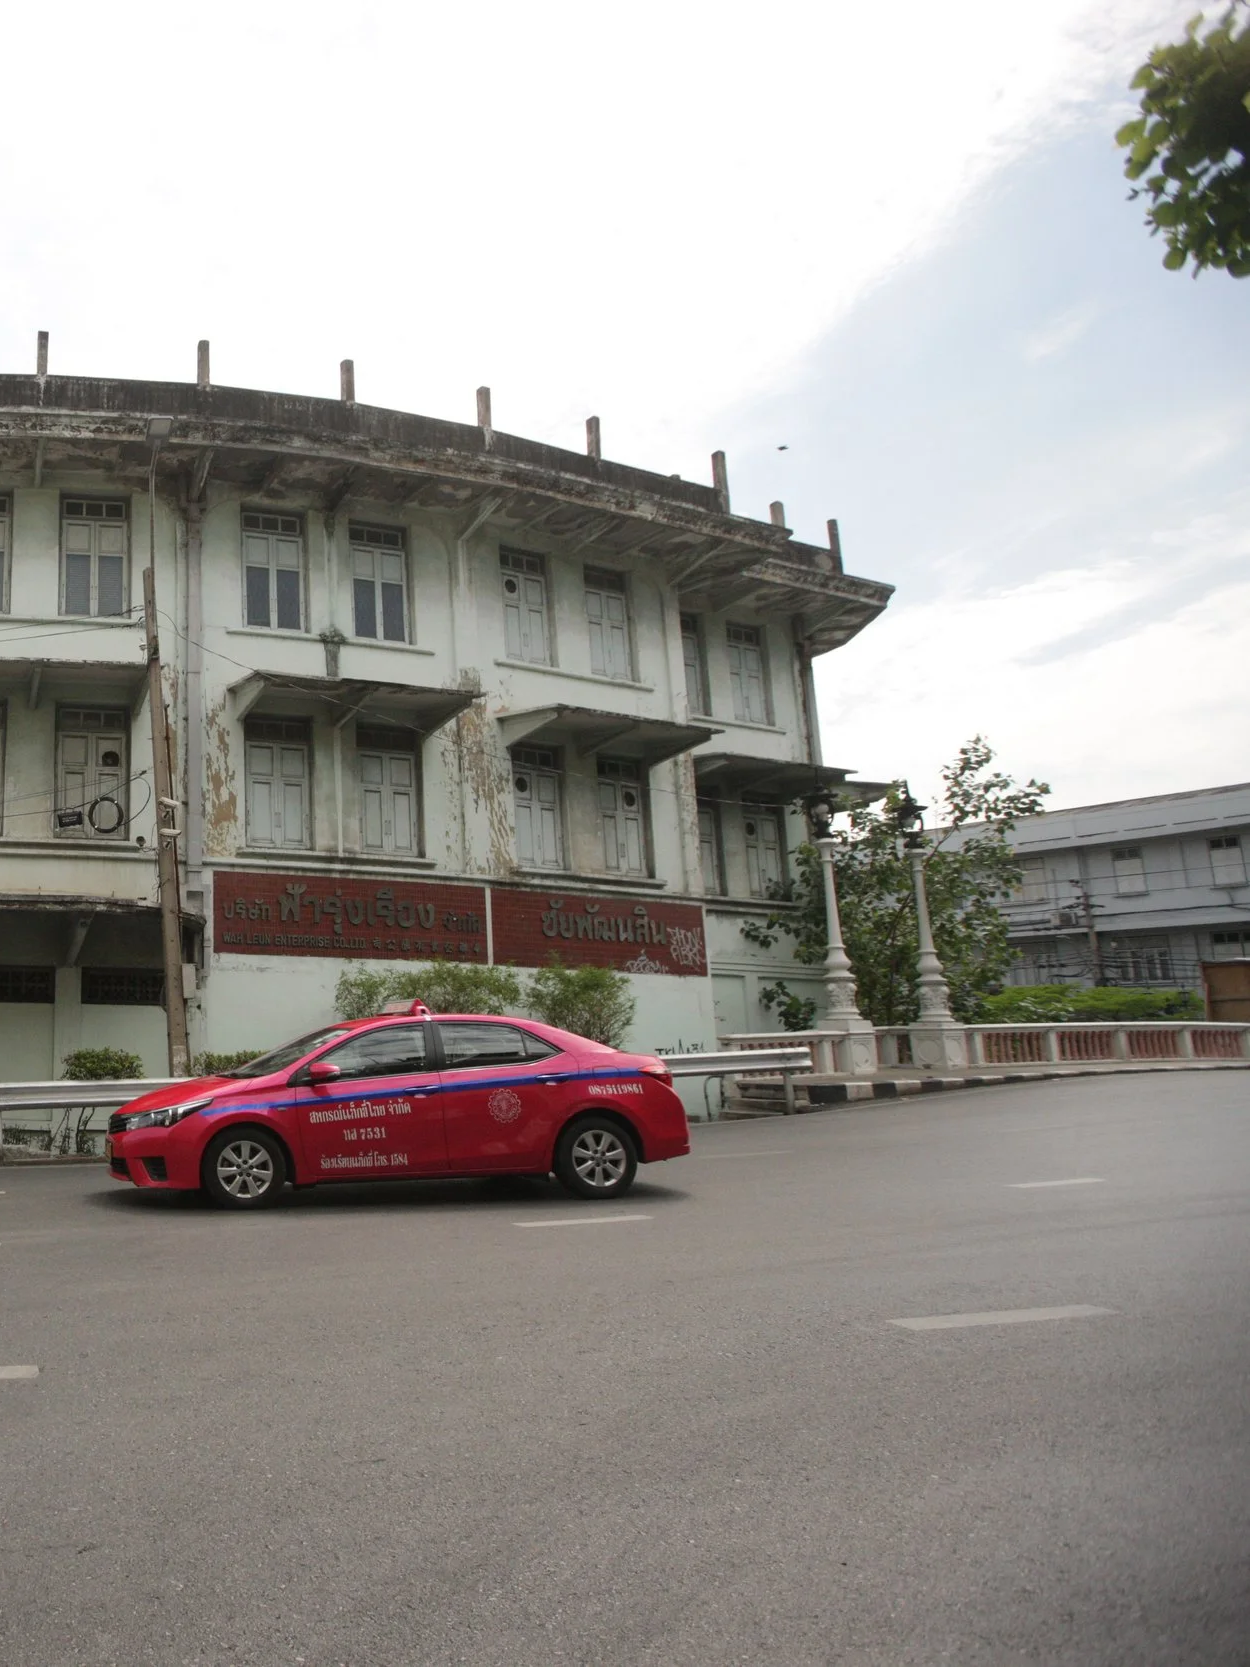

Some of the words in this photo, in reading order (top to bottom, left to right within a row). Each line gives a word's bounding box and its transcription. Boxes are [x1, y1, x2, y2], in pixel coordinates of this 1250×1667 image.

[223, 898, 271, 920] บริษัท
[278, 883, 435, 935] ฟ้ารุ่งเรือง
[542, 900, 667, 945] ชัยพัฒนสิน
[223, 932, 243, 945] WAH
[275, 935, 331, 948] ENTERPRISE
[387, 1098, 412, 1115] จำกัด
[360, 1126, 387, 1140] 7531
[390, 1153, 409, 1166] 1584
